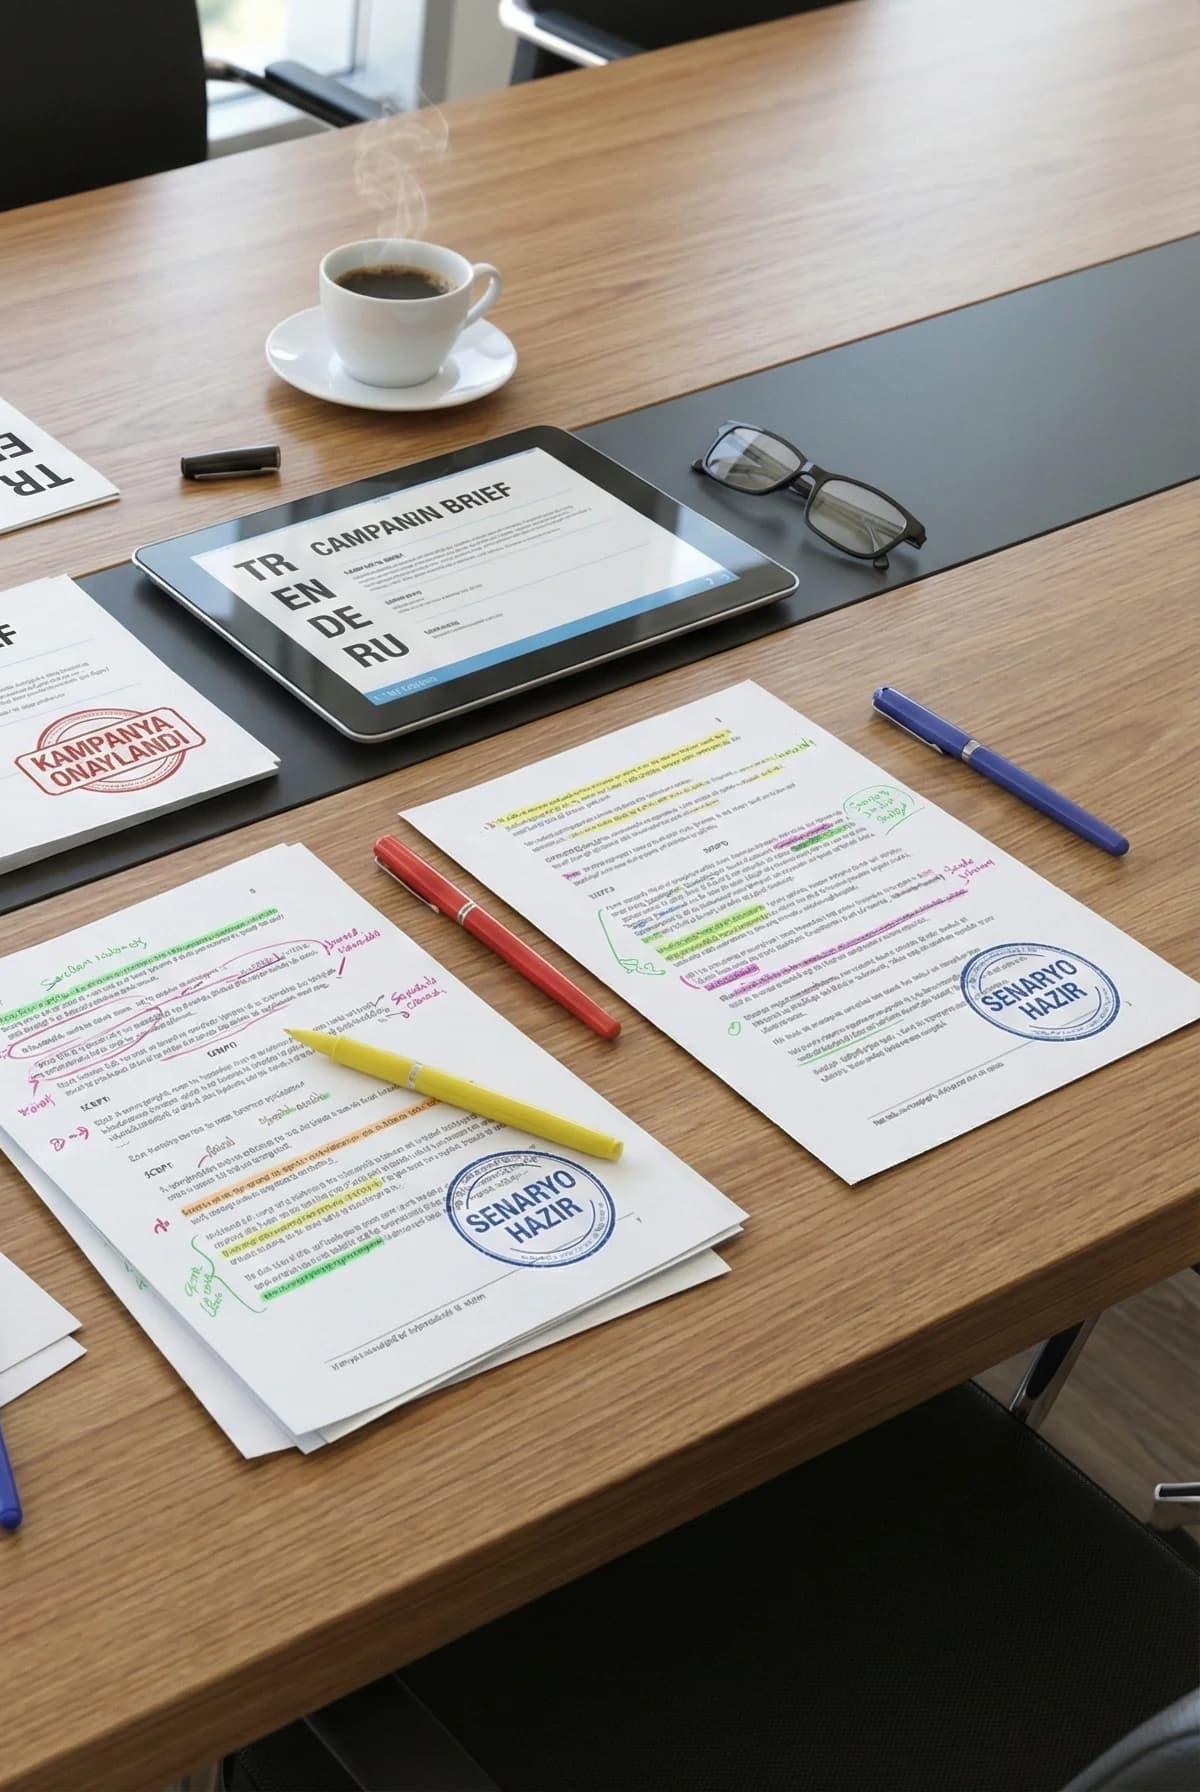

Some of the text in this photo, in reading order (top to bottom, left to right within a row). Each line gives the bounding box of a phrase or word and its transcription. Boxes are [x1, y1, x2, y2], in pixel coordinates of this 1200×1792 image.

[439, 481, 512, 515] BRIEF
[234, 553, 299, 581] TR
[270, 578, 337, 611] EN
[306, 605, 374, 639] DE
[342, 633, 410, 668] RU
[30, 715, 175, 773] KAMPANYA
[49, 730, 190, 787] ONAYLANDI
[980, 958, 1079, 1013] SENARYO
[1017, 981, 1089, 1021] HAZIR
[465, 1169, 578, 1234] SENARYO
[504, 1196, 585, 1245] HAZIR
